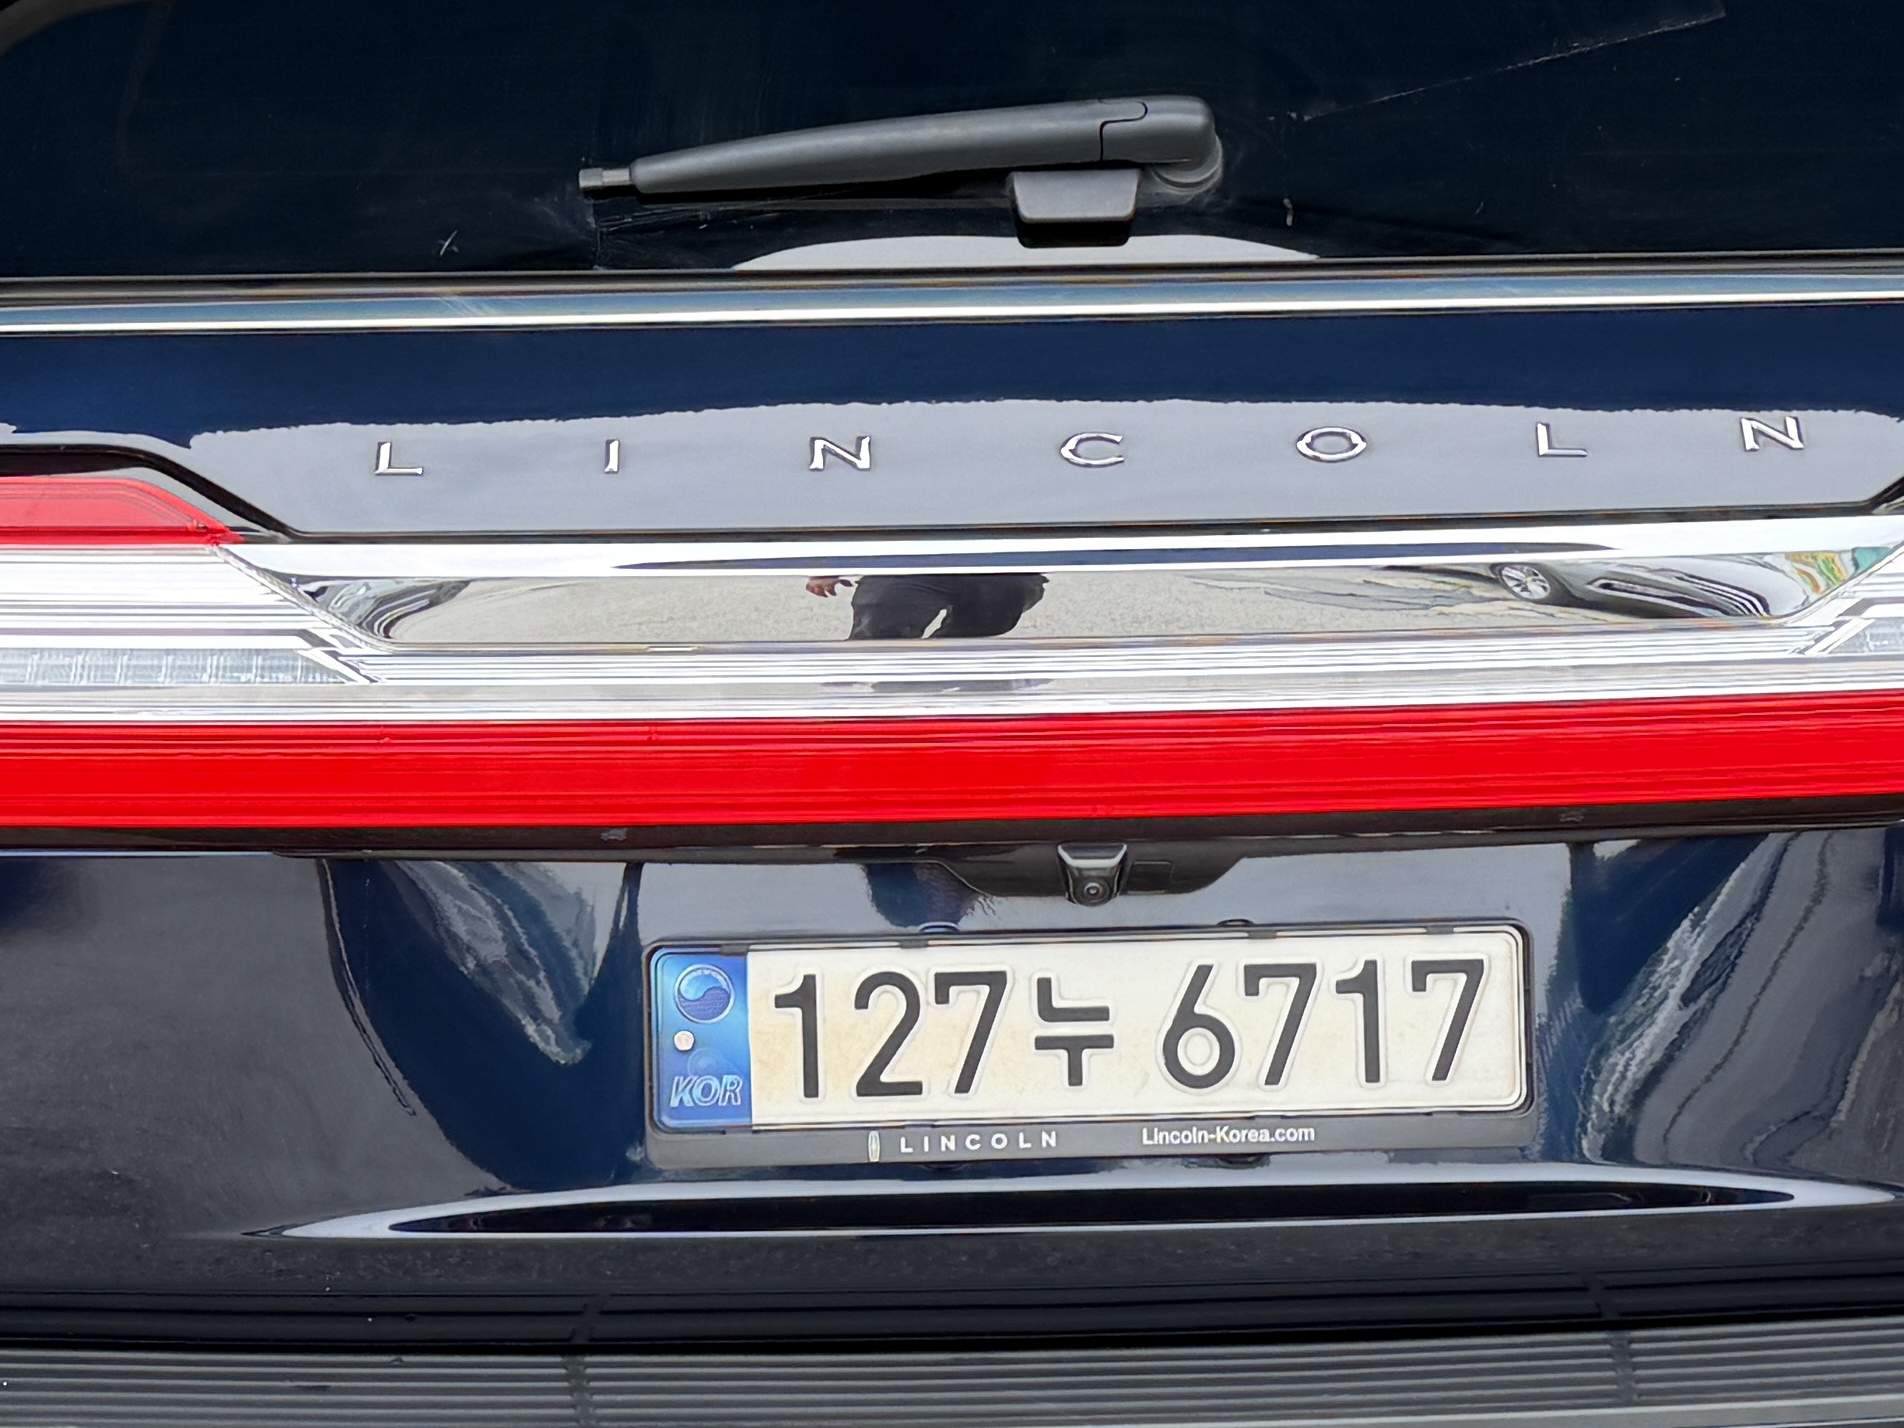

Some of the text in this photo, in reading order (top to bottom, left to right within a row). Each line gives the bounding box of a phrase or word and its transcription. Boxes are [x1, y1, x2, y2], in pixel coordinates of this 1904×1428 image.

[372, 414, 1807, 477] LINCOLN
[773, 957, 1487, 1100] 127누 6717
[669, 1074, 744, 1108] KOR
[900, 1130, 1058, 1154] LINCOLN
[1141, 1125, 1316, 1147] Lincoln-Korea.com
